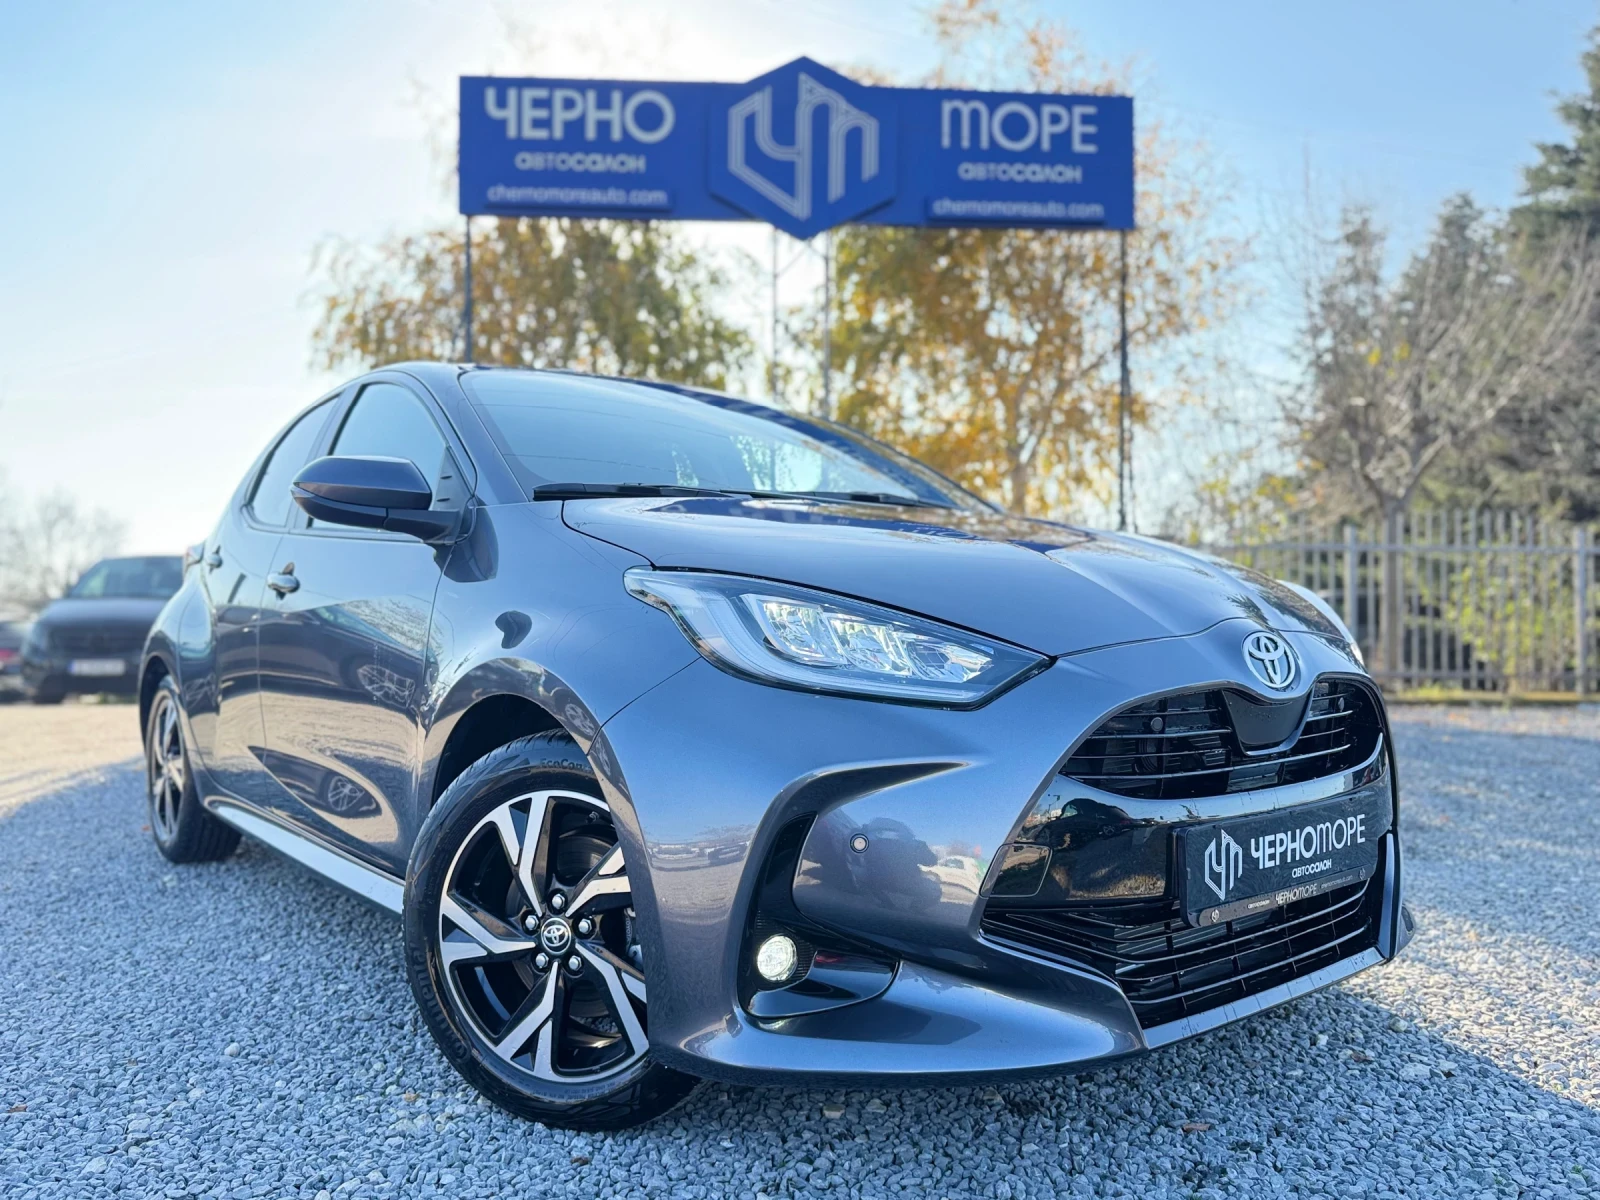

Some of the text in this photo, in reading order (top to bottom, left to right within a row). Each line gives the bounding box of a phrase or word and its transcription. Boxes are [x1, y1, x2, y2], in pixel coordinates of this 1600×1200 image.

[485, 86, 675, 143] ЧЕРНО
[941, 99, 1098, 153] МОРЕ
[1250, 814, 1366, 869] ЧЕРНОМОРЕ
[1291, 859, 1332, 878] автосалон
